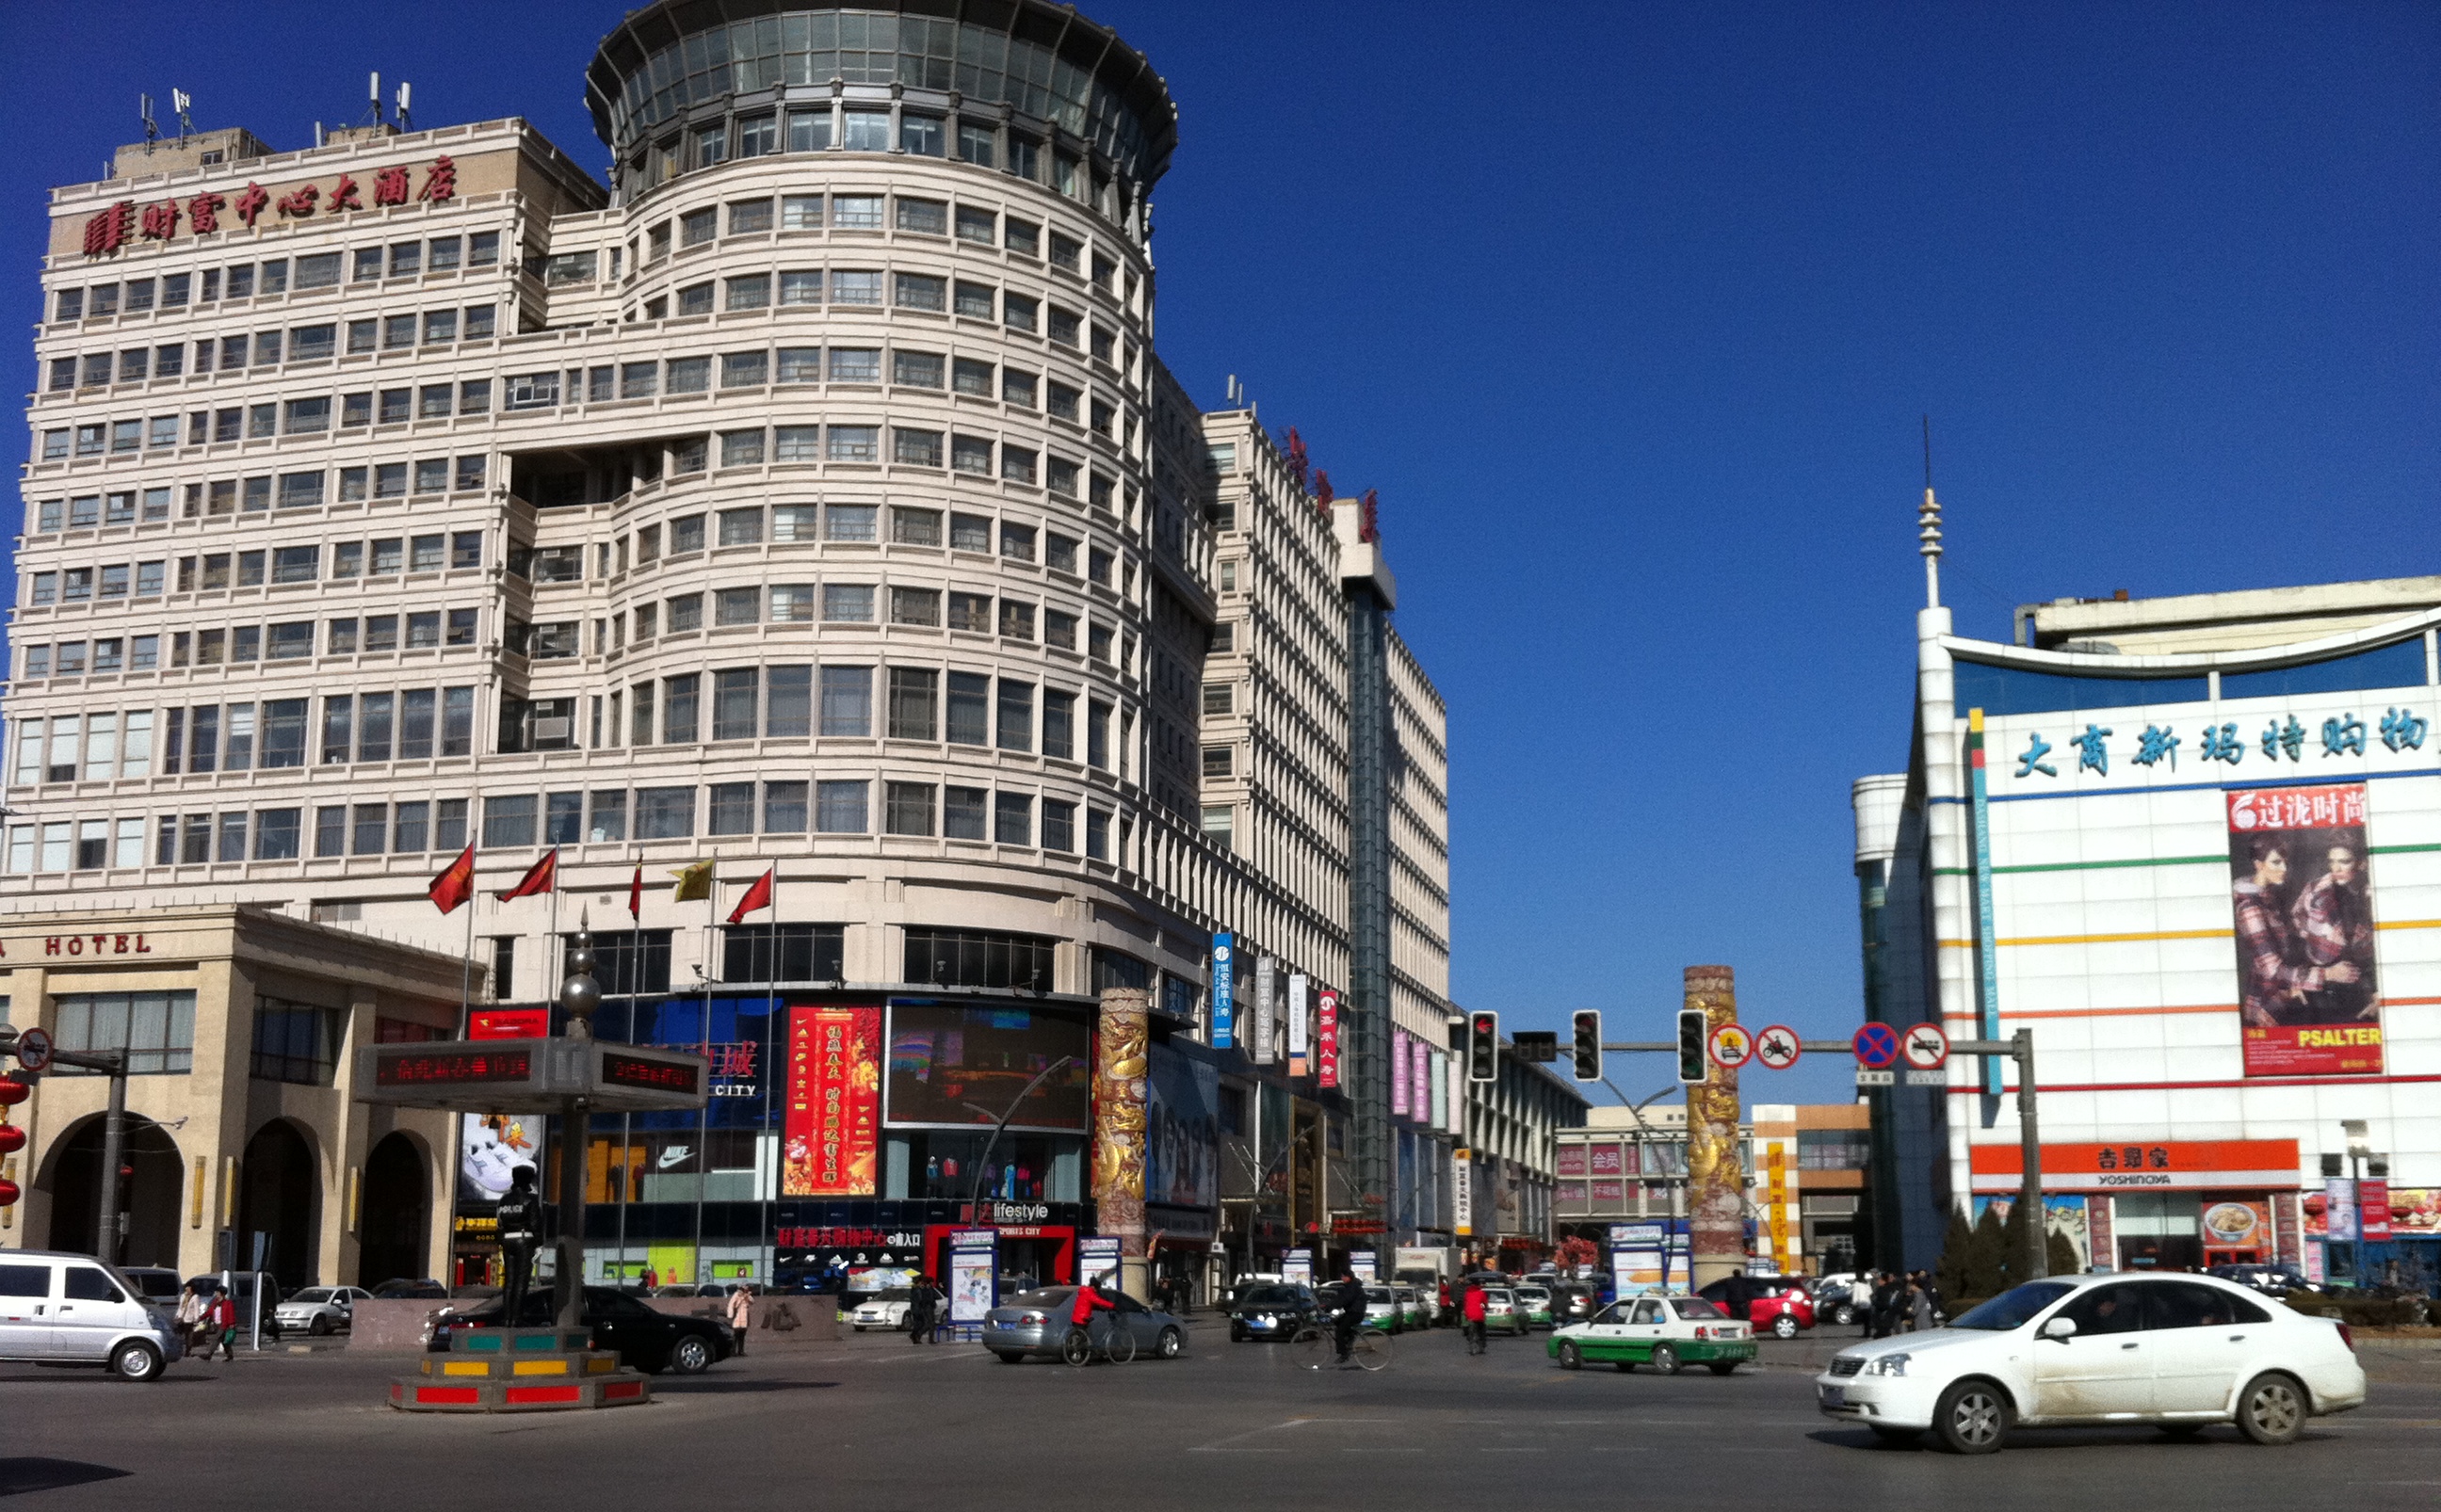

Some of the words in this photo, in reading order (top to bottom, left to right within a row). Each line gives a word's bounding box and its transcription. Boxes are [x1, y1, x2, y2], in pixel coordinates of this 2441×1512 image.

[140, 155, 457, 240] 财富中心大酒店
[2014, 706, 2430, 780] 大商新玛特购物
[44, 935, 151, 956] HOTEL
[2299, 1028, 2383, 1048] PSALTER
[715, 1085, 756, 1097] CITY
[1592, 1151, 1620, 1168] 会员
[498, 1205, 524, 1214] POLICE
[994, 1202, 1048, 1221] lifestyle
[1025, 1227, 1042, 1235] CITY
